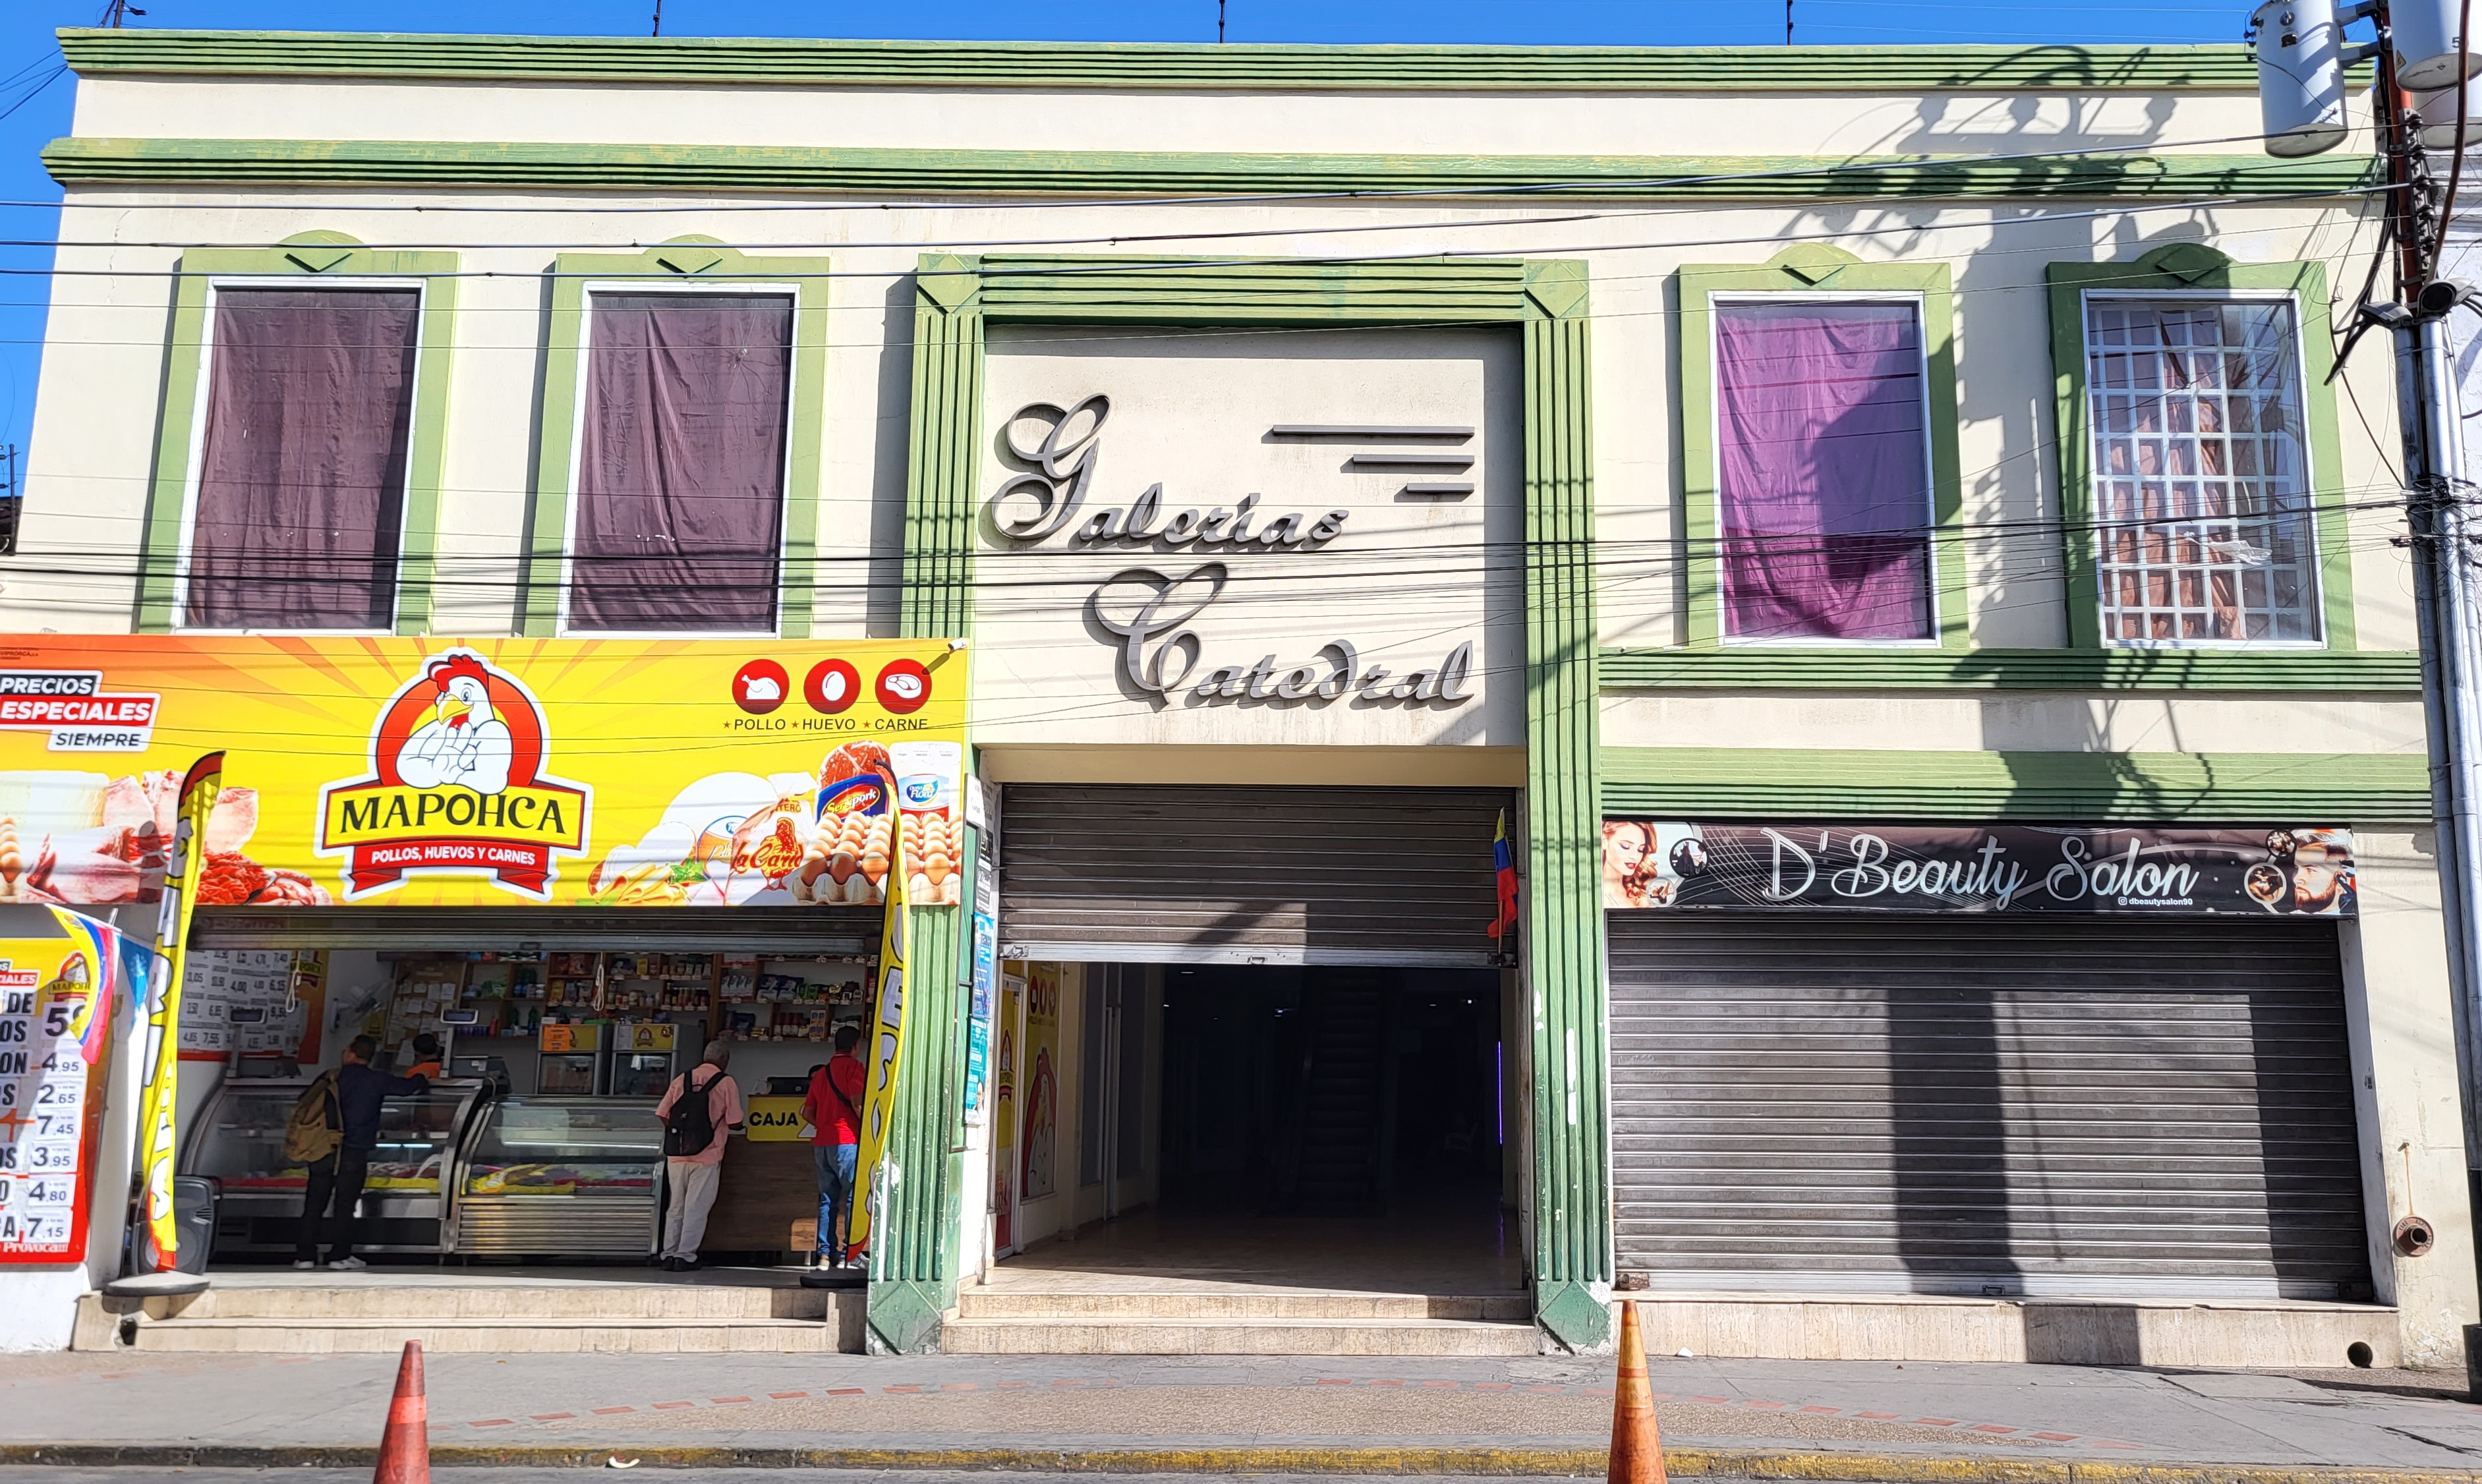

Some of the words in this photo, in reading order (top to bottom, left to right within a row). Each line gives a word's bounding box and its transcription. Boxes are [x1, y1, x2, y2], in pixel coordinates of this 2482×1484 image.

[1094, 561, 1474, 711] Catedral
[1, 677, 93, 694] PRECIOS
[1, 701, 151, 720] ESPECIALES
[734, 719, 786, 729] POLLO
[803, 719, 855, 729] HUEVO
[875, 719, 928, 730] CARNE
[55, 733, 141, 746] SIEMPRE
[340, 793, 567, 834] MAPOHCA
[372, 847, 422, 864] POLLOS,
[425, 846, 475, 860] HUEVOS
[476, 847, 486, 859] Y
[488, 847, 535, 865] CARNES
[2046, 836, 2200, 901] Salon
[2129, 897, 2193, 906] dbeautysalon90
[8, 992, 33, 1013] DE
[749, 1112, 798, 1126] CAJA
